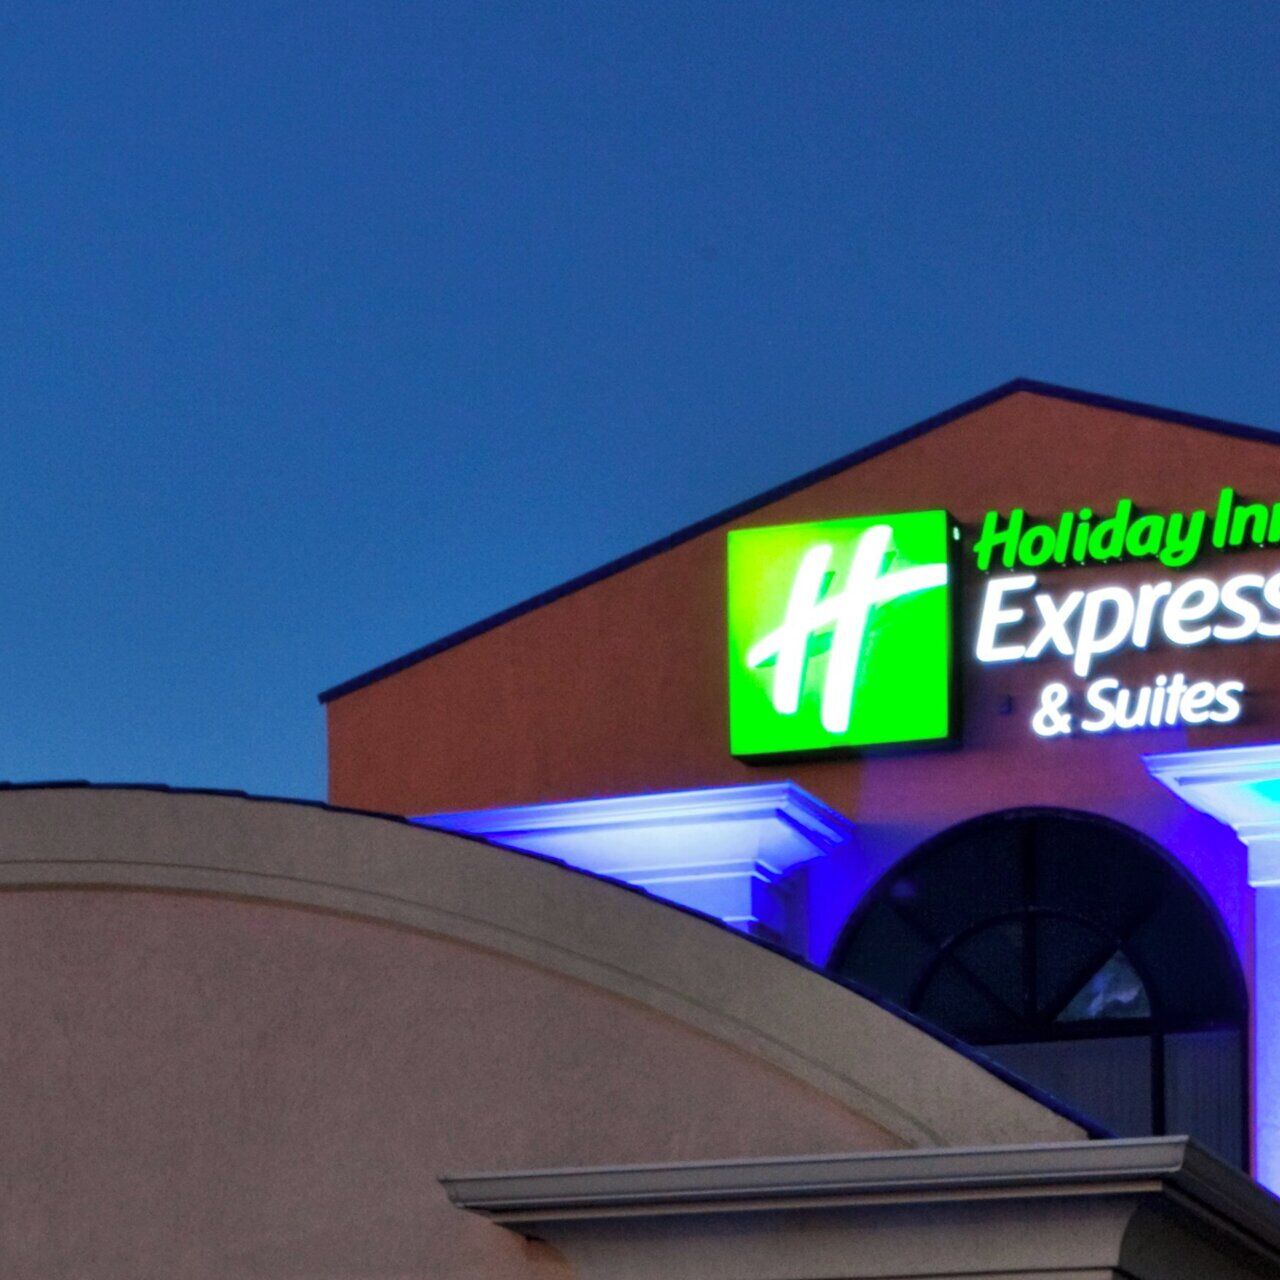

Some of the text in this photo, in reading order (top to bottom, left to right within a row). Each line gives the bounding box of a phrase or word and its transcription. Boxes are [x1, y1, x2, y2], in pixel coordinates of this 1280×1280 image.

[972, 498, 1207, 572] Holiday
[745, 523, 949, 734] H
[1030, 672, 1245, 737] & Suites
